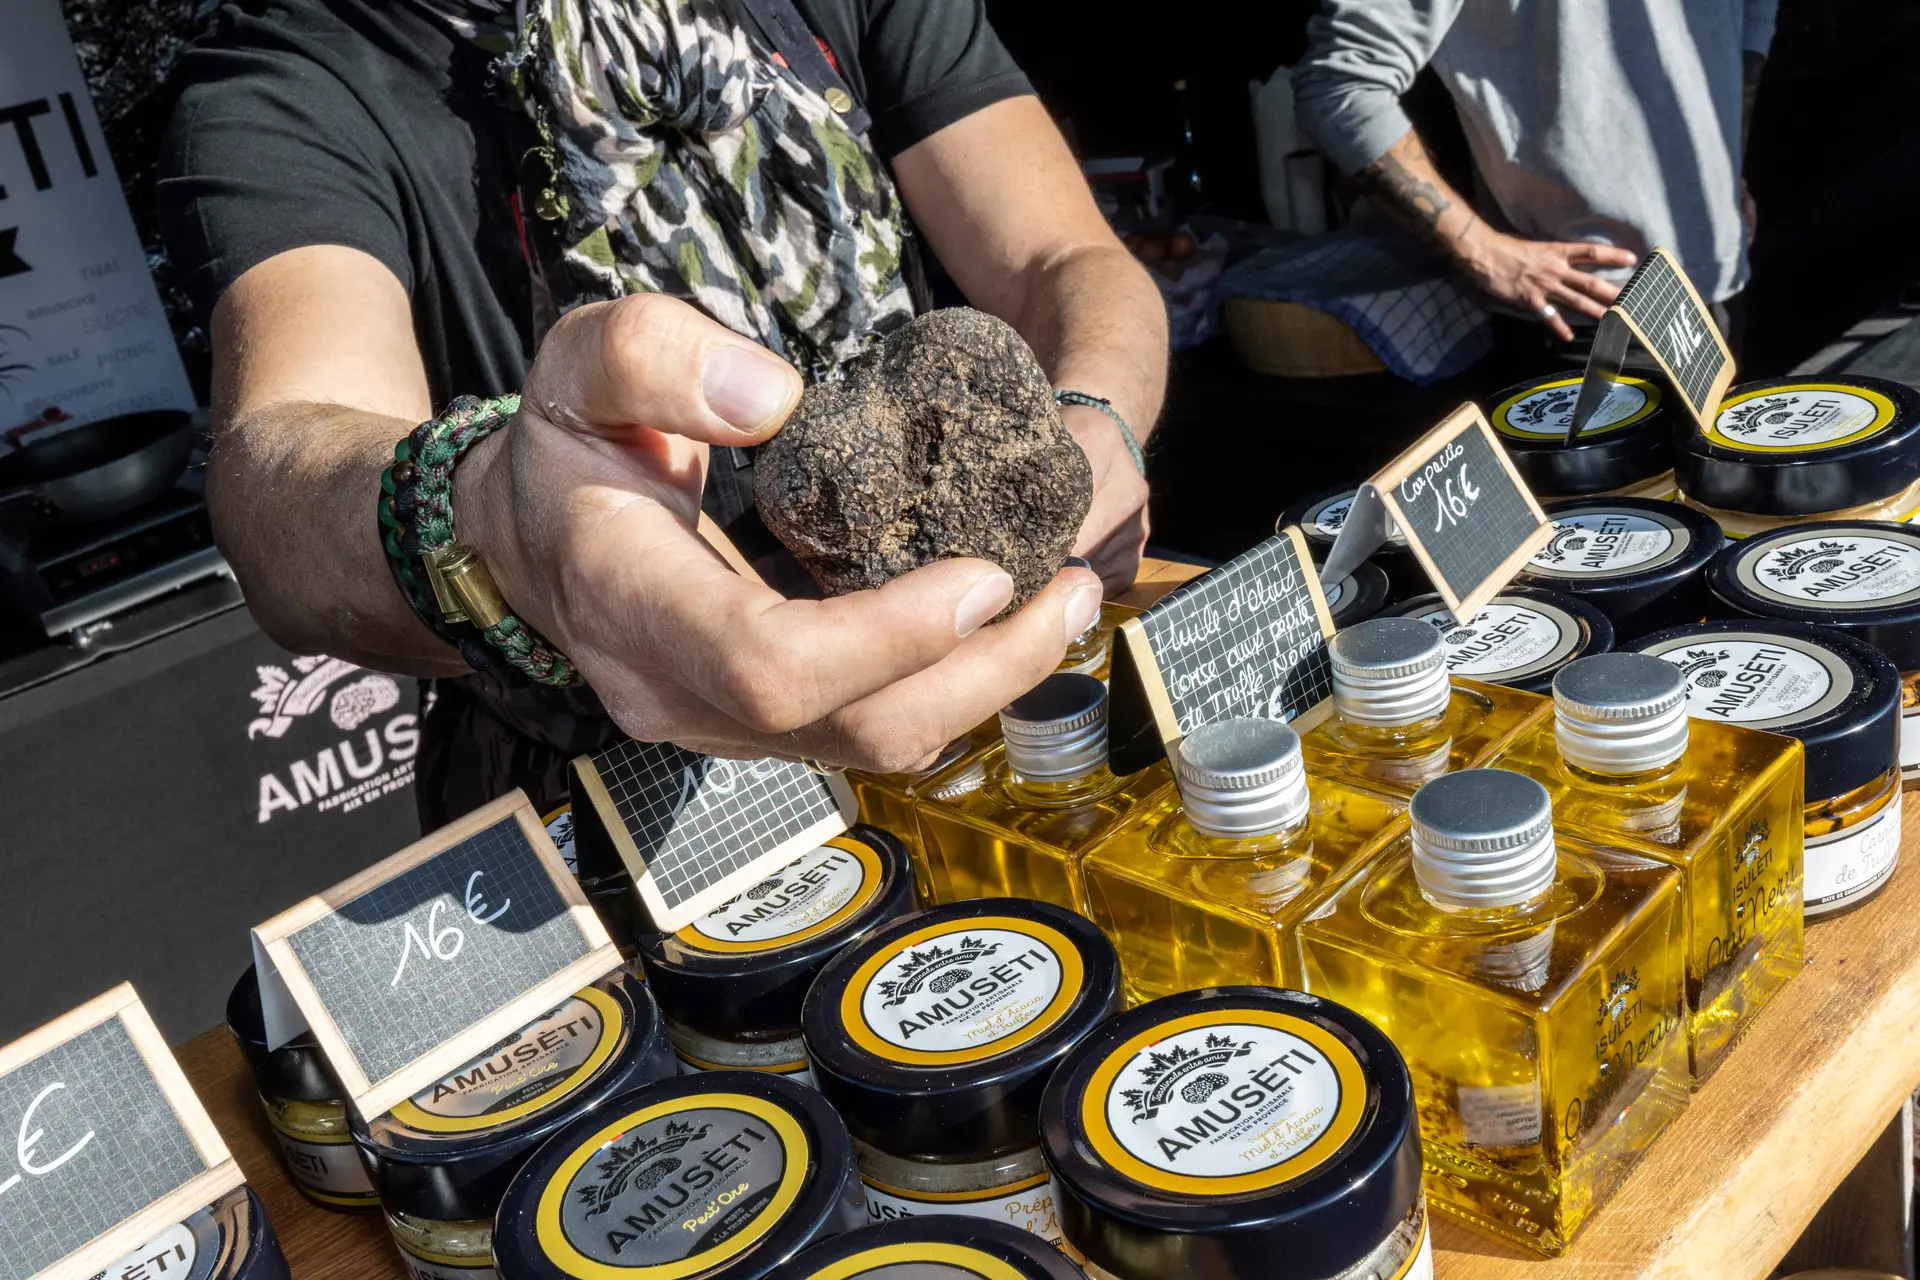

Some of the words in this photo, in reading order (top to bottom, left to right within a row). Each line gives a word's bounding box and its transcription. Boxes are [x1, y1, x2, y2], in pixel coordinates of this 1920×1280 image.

[0, 91, 98, 192] TI
[79, 259, 120, 282] THAI
[1768, 399, 1841, 439] ISULÈTI
[1434, 463, 1480, 533] 16€
[1802, 545, 1910, 598] AMUSÈTI
[1447, 613, 1538, 670] AMUSÈTI
[1705, 648, 1787, 718] AMUSÈTI
[259, 713, 420, 824] AMUS
[318, 772, 391, 813] FABRICATION
[343, 797, 363, 813] AIX
[364, 788, 381, 803] EN
[725, 855, 850, 937] AMUSÈTI
[1733, 848, 1773, 902] ISULÈTI
[1821, 893, 1836, 904] DATE
[1835, 864, 1856, 885] de
[390, 871, 511, 987] 16€
[898, 949, 1048, 1040] AMUSÈTI
[941, 1002, 985, 1027] FABRICATION
[985, 979, 1024, 1003] ARTISANALE
[959, 1015, 971, 1023] AIX
[982, 990, 1017, 1010] PROVENCE
[963, 1020, 997, 1040] Miel
[1595, 998, 1643, 1060] ISULÈTI
[432, 1015, 594, 1104] AMUSÈTI
[463, 1069, 519, 1096] FABRICATION
[521, 1042, 571, 1071] ARTISANALE
[1182, 1060, 1204, 1073] entre
[1203, 1053, 1227, 1063] amis
[512, 1098, 522, 1106] LA
[521, 1086, 546, 1101] TRUFFE
[545, 1076, 566, 1090] NOIRE
[522, 1082, 544, 1095] PESTO
[1157, 1048, 1317, 1163] AMUSÈTI
[1209, 1114, 1255, 1145] FABRICATION
[1255, 1085, 1295, 1115] ARTISANALE
[1229, 1130, 1242, 1141] AIX
[1242, 1123, 1254, 1133] EN
[1253, 1098, 1289, 1126] PROVENCE
[1277, 1123, 1321, 1151] Truffes
[1238, 1137, 1277, 1162] Miel
[606, 1127, 768, 1256] AMUSÈTI
[647, 1200, 702, 1240] FABRICATION
[702, 1158, 752, 1199] ARTISANALE
[866, 1196, 915, 1222] US
[718, 1230, 729, 1239] LA
[727, 1212, 752, 1232] TRUFFE
[749, 1197, 770, 1214] NOIRE
[723, 1207, 745, 1226] PESTO
